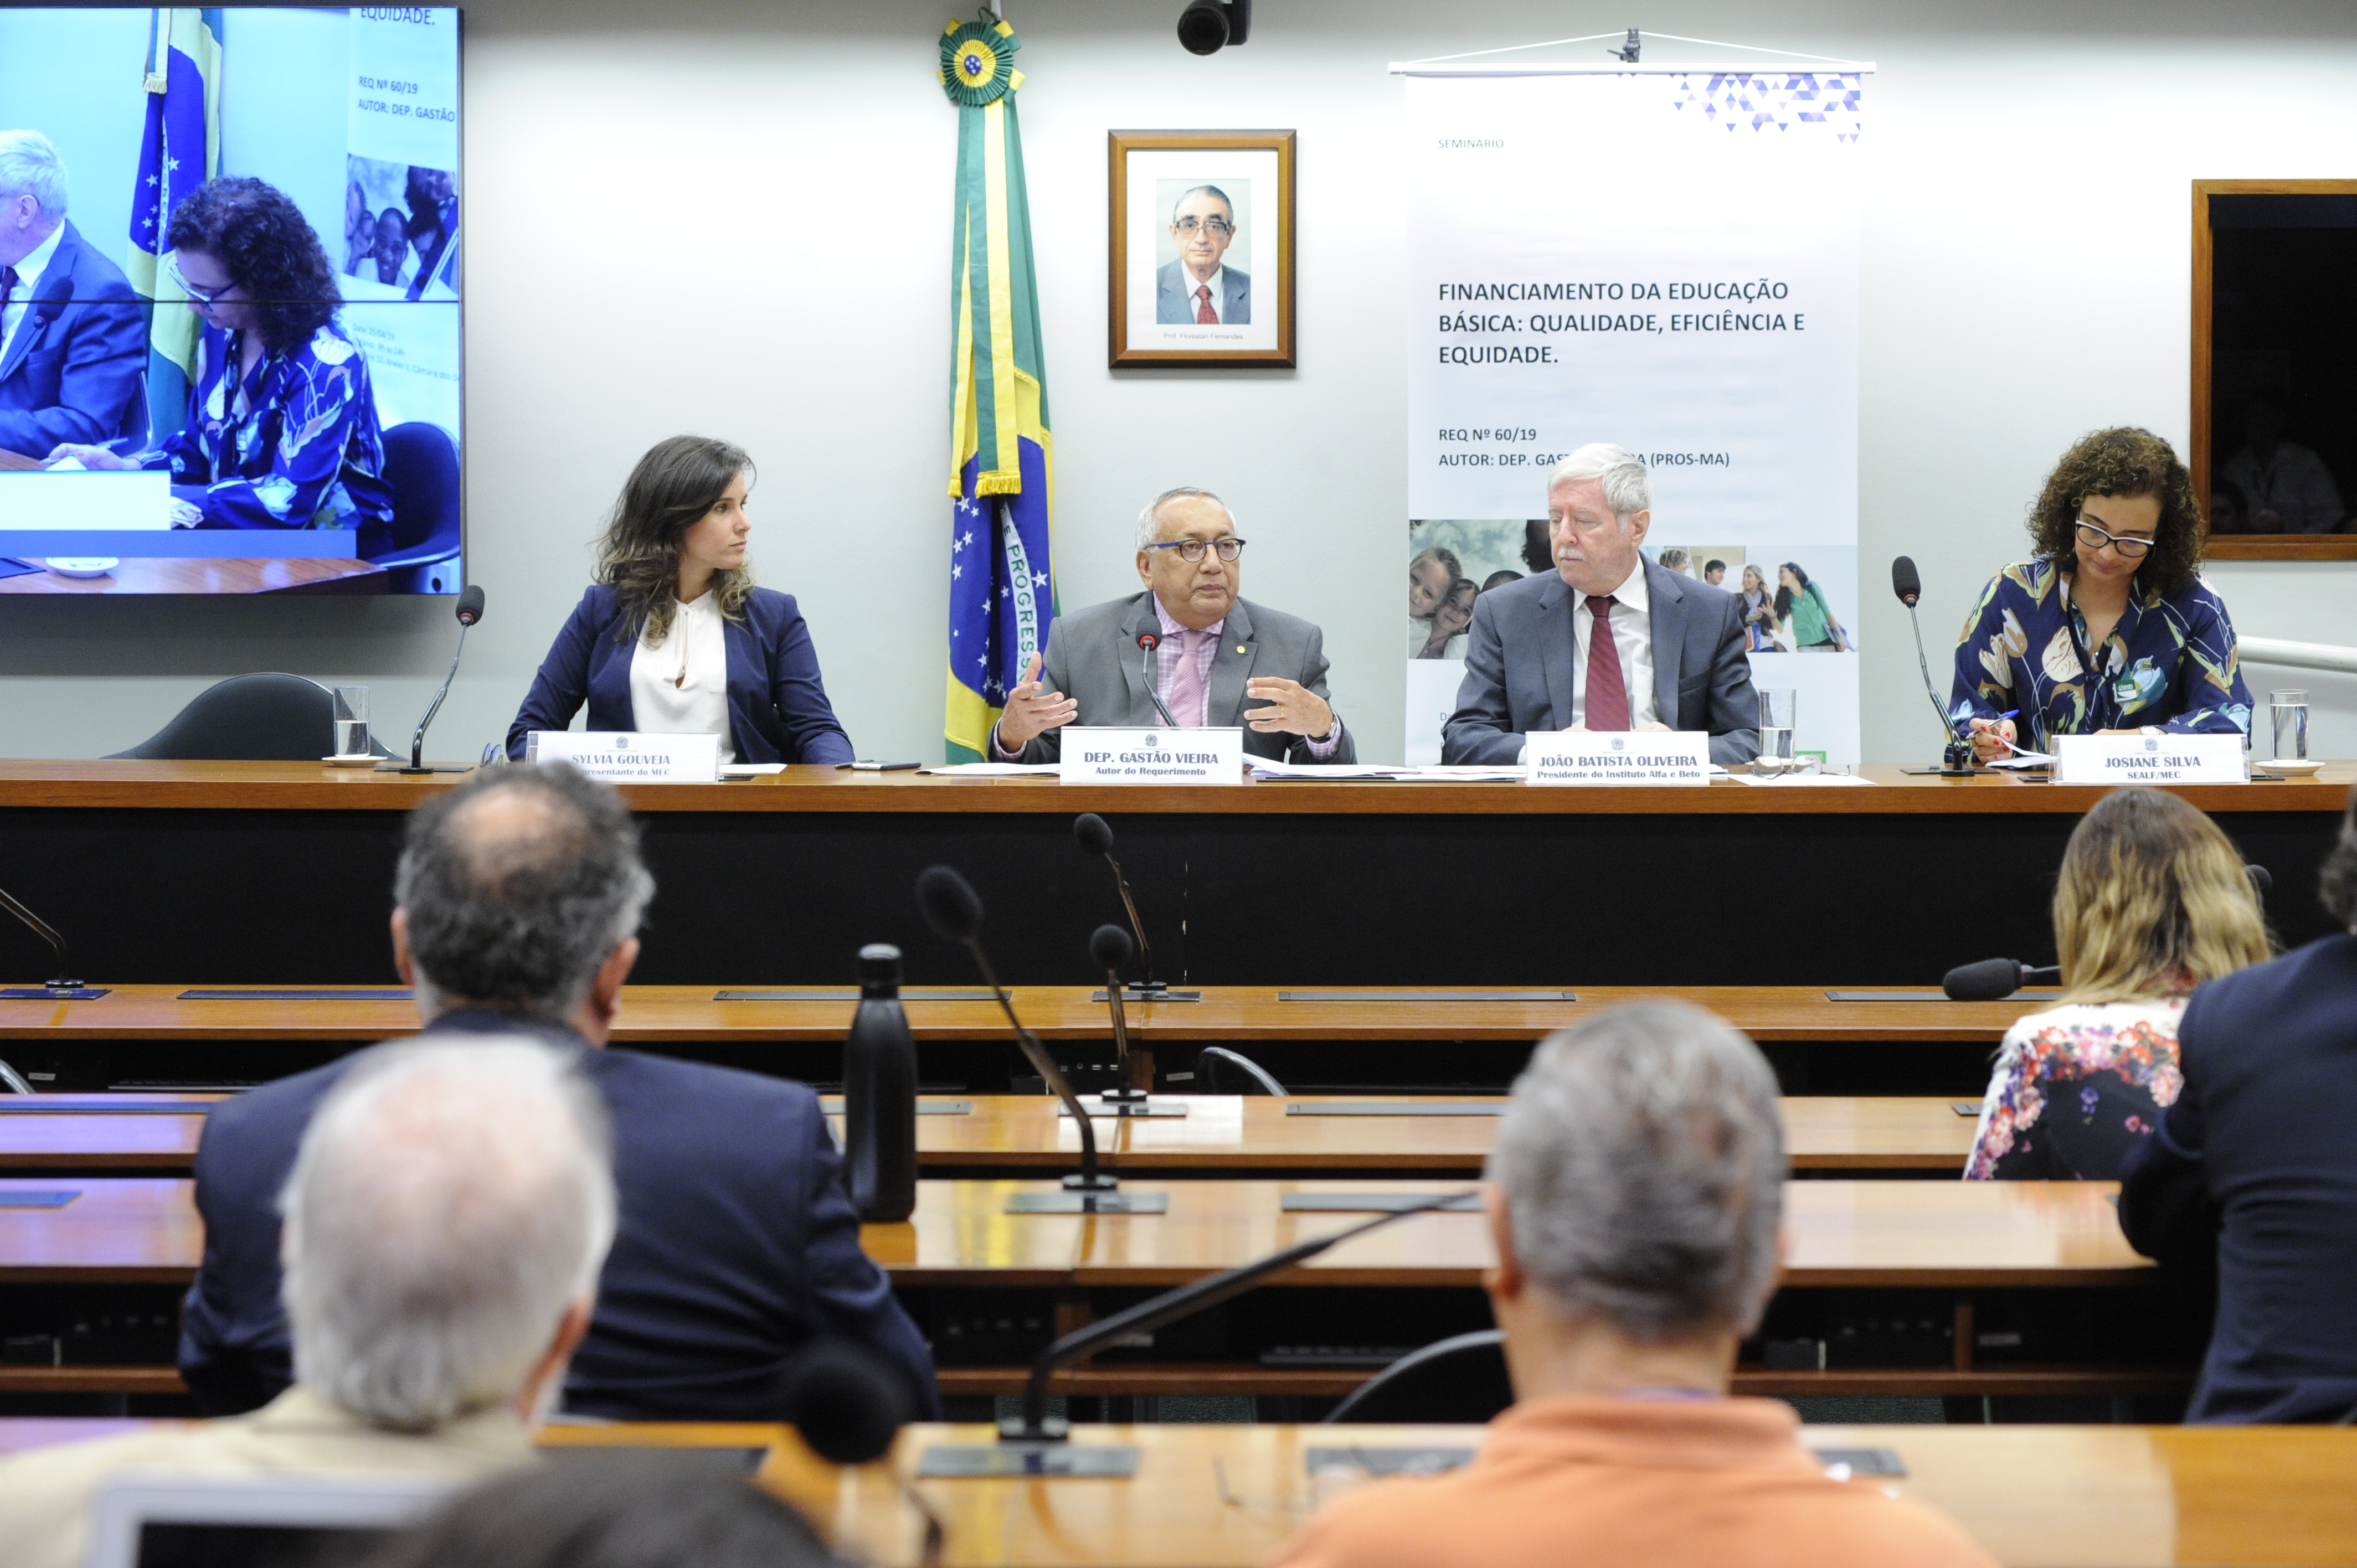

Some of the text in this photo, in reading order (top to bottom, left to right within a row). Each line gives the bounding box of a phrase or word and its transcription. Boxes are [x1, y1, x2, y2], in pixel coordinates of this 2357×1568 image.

[362, 7, 435, 25] EQUIDADE.
[359, 76, 374, 90] REQ
[390, 81, 418, 94] 60/19
[358, 99, 455, 122] AUTOR: DEP. GASTÃO
[1439, 137, 1504, 148] SEMINÁRIO
[1439, 278, 1788, 303] FINANCIAMENTO DA EDUCAÇÃO
[1439, 309, 1805, 334] BÁSICA: QUALIDADE, EFICIÊNCIA E
[1439, 346, 1559, 367] EQUIDADE.
[1439, 429, 1537, 442] REQ Nº 60/19
[1439, 454, 1494, 466] AUTOR:
[1499, 454, 1531, 466] DEP.
[1650, 452, 1730, 467] (PROS-MA)
[1003, 525, 1035, 683] E PROGRESS
[572, 754, 670, 765] SYLVIA GOUVEIA
[1084, 751, 1219, 764] DEP. GASTÃO VIEIRA
[1539, 755, 1697, 767] JOÃO BATISTA OLIVEIRA
[2105, 756, 2201, 768] JOSIANE SILVA
[1140, 767, 1206, 776] Requerimento
[2127, 771, 2181, 780] SEALF/MEC
